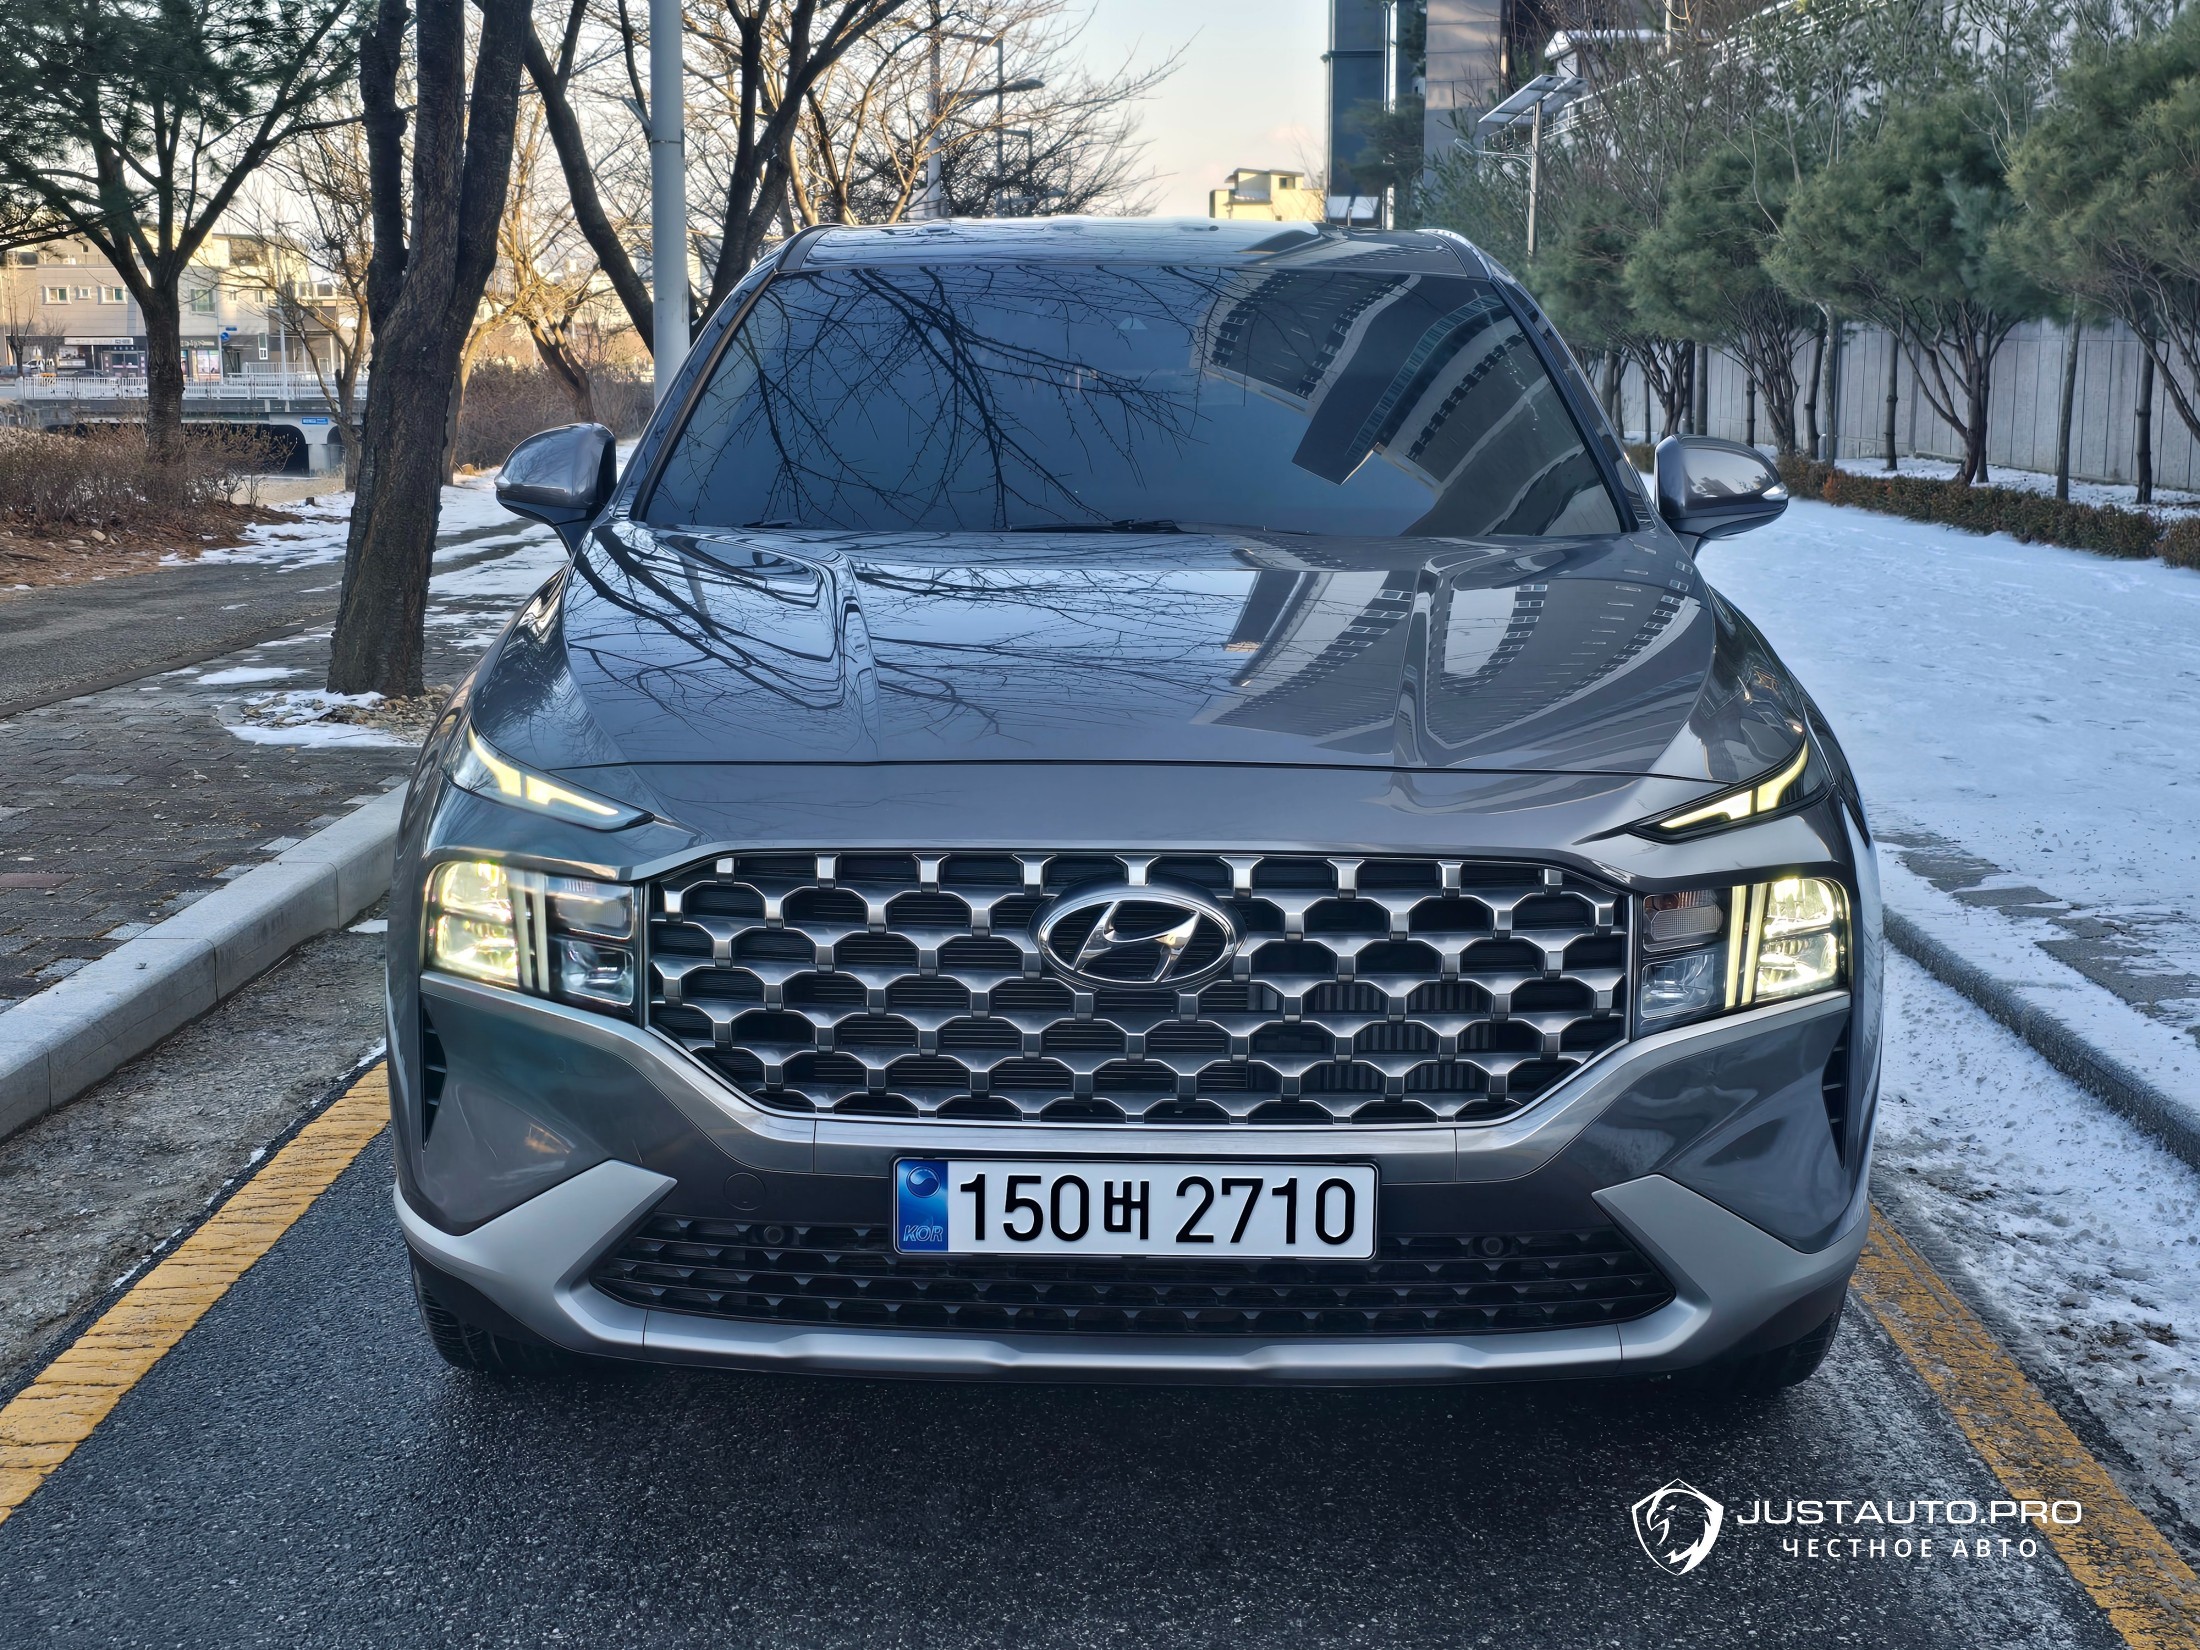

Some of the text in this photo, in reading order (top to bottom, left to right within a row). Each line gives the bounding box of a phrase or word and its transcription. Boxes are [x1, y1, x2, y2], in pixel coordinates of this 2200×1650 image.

[960, 1173, 1356, 1246] 150버 2710
[903, 1224, 944, 1242] KOR
